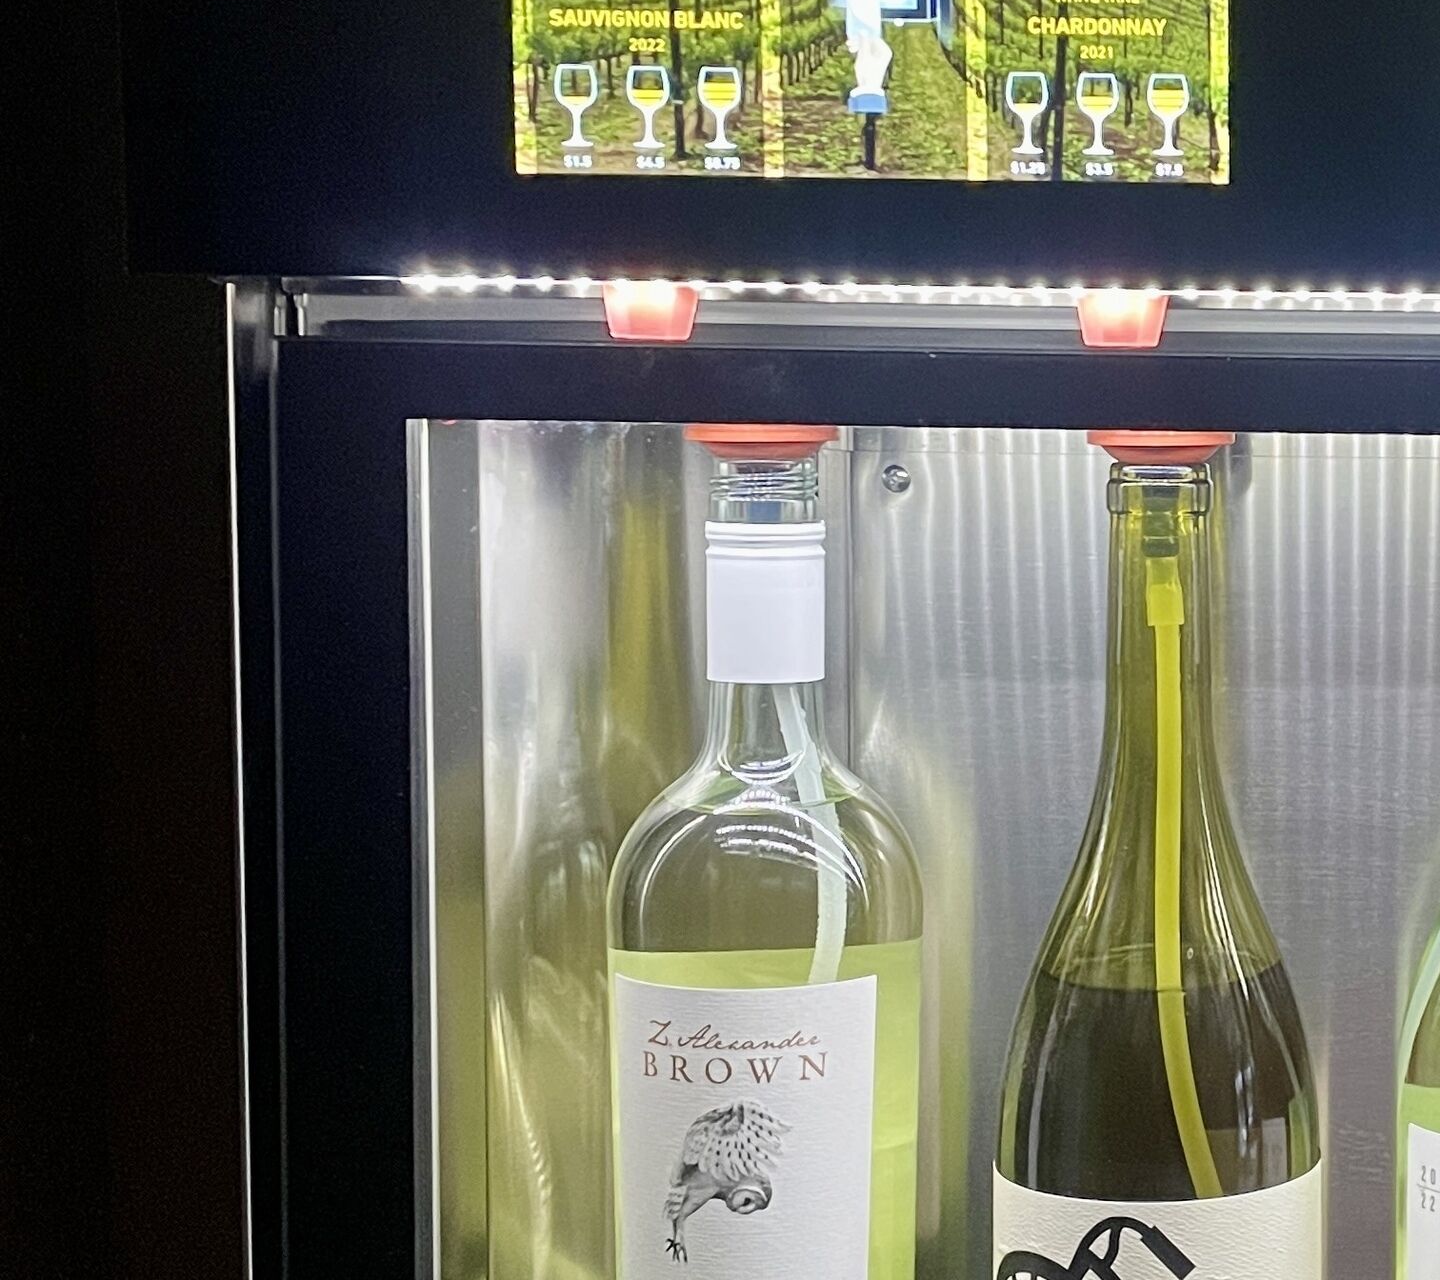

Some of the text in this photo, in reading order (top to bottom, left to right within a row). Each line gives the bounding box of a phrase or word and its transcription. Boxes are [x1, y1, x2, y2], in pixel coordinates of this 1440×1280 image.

[549, 8, 744, 29] SAUVIGNON BLANC
[1027, 16, 1167, 36] CHARDONNAY
[628, 37, 665, 52] 2022
[1080, 45, 1113, 59] 2021
[678, 1024, 821, 1051] Alexander
[643, 1050, 828, 1084] BROWN
